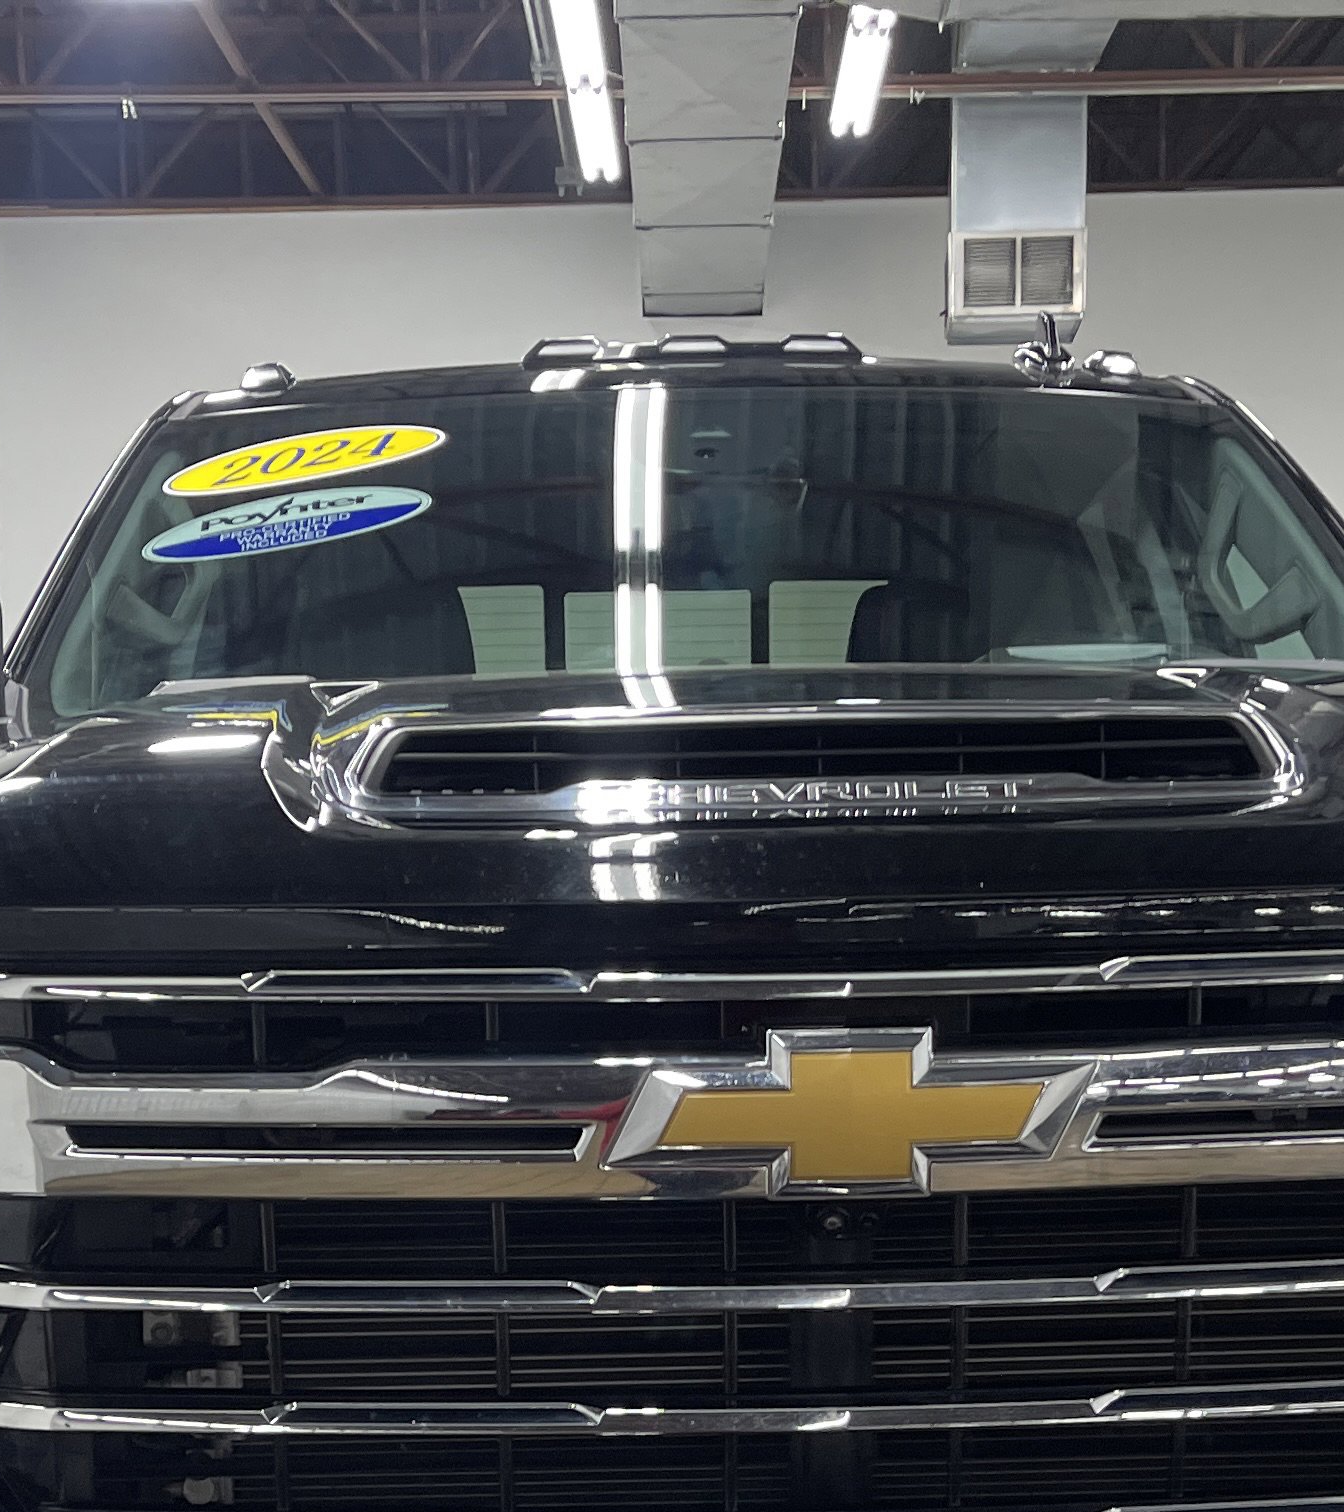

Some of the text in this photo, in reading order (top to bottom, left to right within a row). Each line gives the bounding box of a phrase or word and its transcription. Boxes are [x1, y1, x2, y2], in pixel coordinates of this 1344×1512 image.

[212, 431, 398, 487] 2024
[237, 522, 333, 547] WARRANTY
[241, 530, 327, 551] INCLUDED
[620, 777, 1034, 805] HEVROLET
